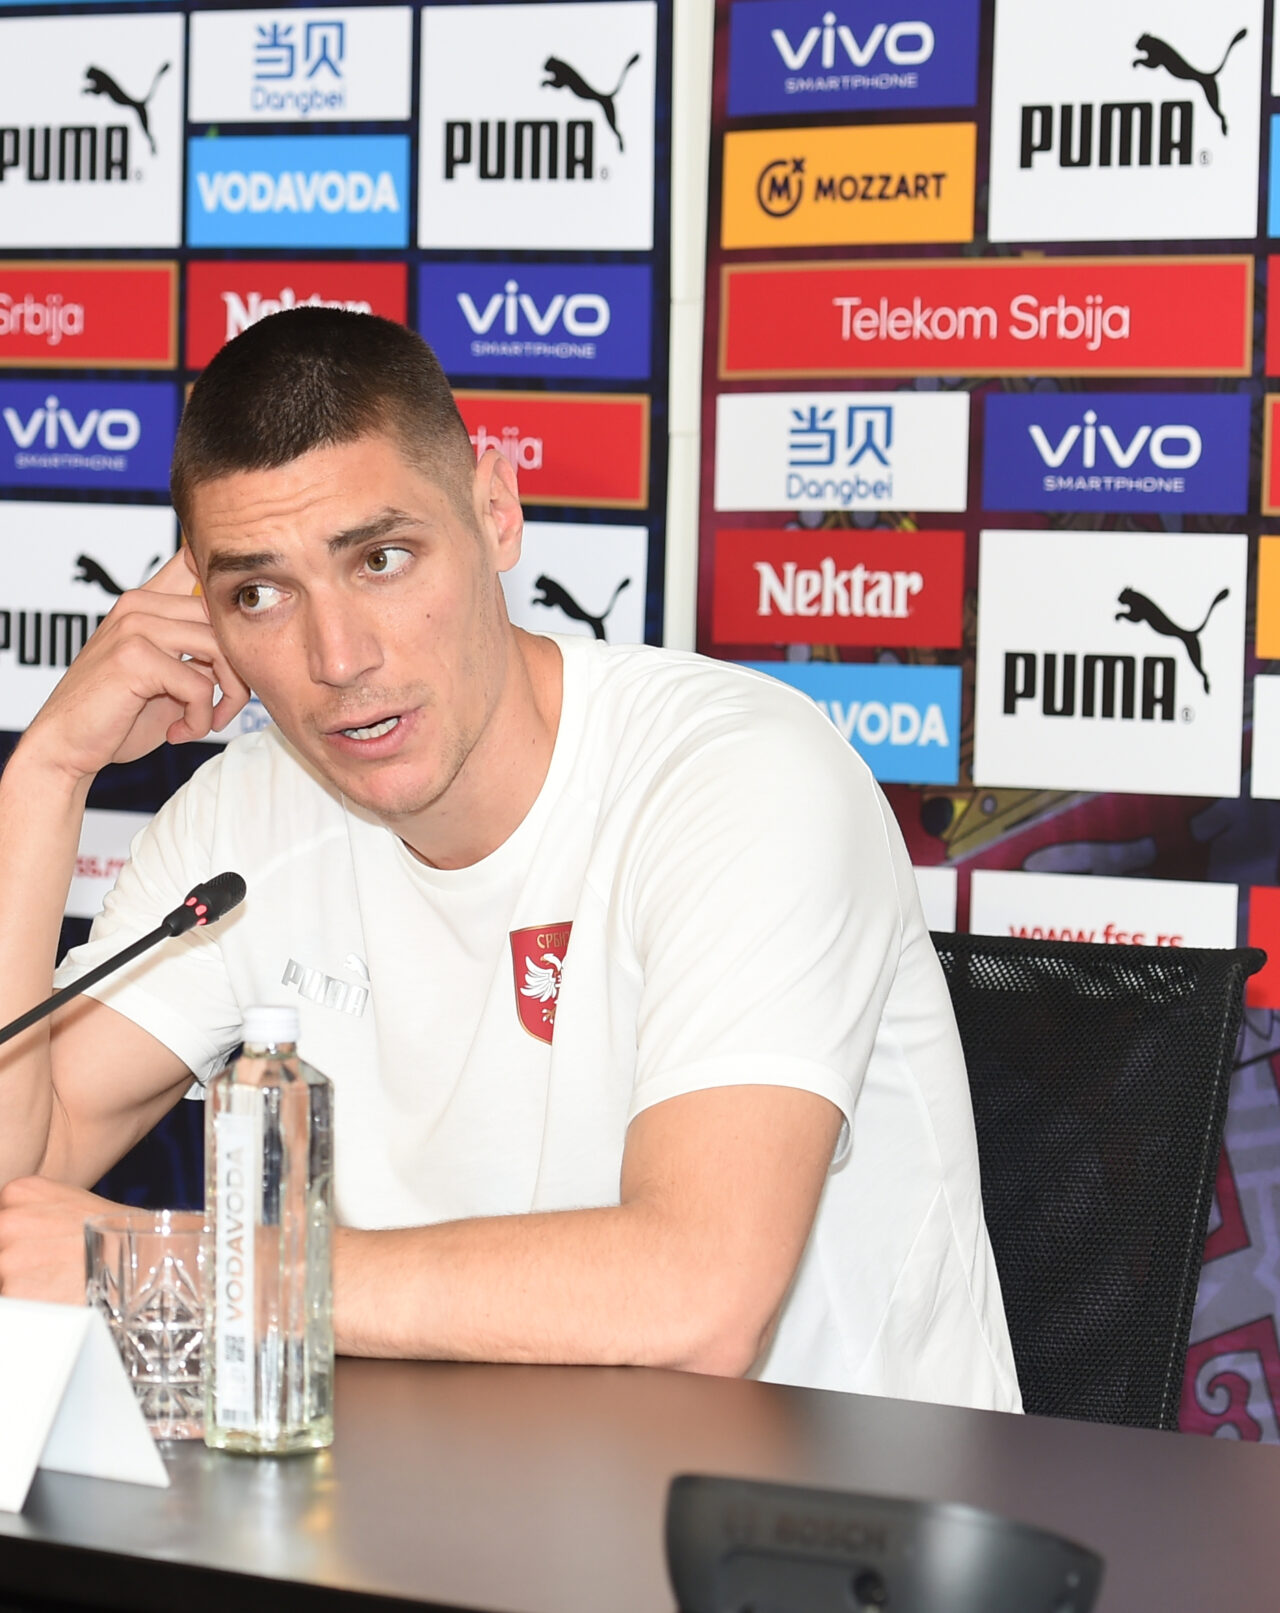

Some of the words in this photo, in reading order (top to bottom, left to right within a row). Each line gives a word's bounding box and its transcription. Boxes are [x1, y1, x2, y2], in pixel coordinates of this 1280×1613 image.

[254, 21, 345, 79] 当贝
[771, 11, 935, 70] vivo
[252, 86, 346, 116] Dangbei
[785, 72, 918, 94] SMARTPHONE
[444, 120, 594, 181] PUMA
[1020, 100, 1194, 169] PUMA
[196, 171, 399, 213] VODAVODA
[813, 172, 948, 202] MOZZART
[457, 279, 611, 337] vivo
[832, 296, 998, 342] Telekom
[1009, 294, 1130, 351] Srbija
[471, 341, 596, 359] SMARTPHONE
[3, 395, 141, 451] vivo
[788, 405, 894, 467] 当贝
[1028, 410, 1203, 470] vivo
[786, 473, 894, 507] Dangbei
[1043, 474, 1186, 493] SMARTPHONE
[754, 557, 924, 618] Nektar
[1003, 652, 1176, 721] PUMA
[817, 700, 950, 748] VODA
[1009, 923, 1183, 947] wwwfssrs
[282, 957, 370, 1018] PUMA
[225, 1146, 245, 1321] VODAVODA
